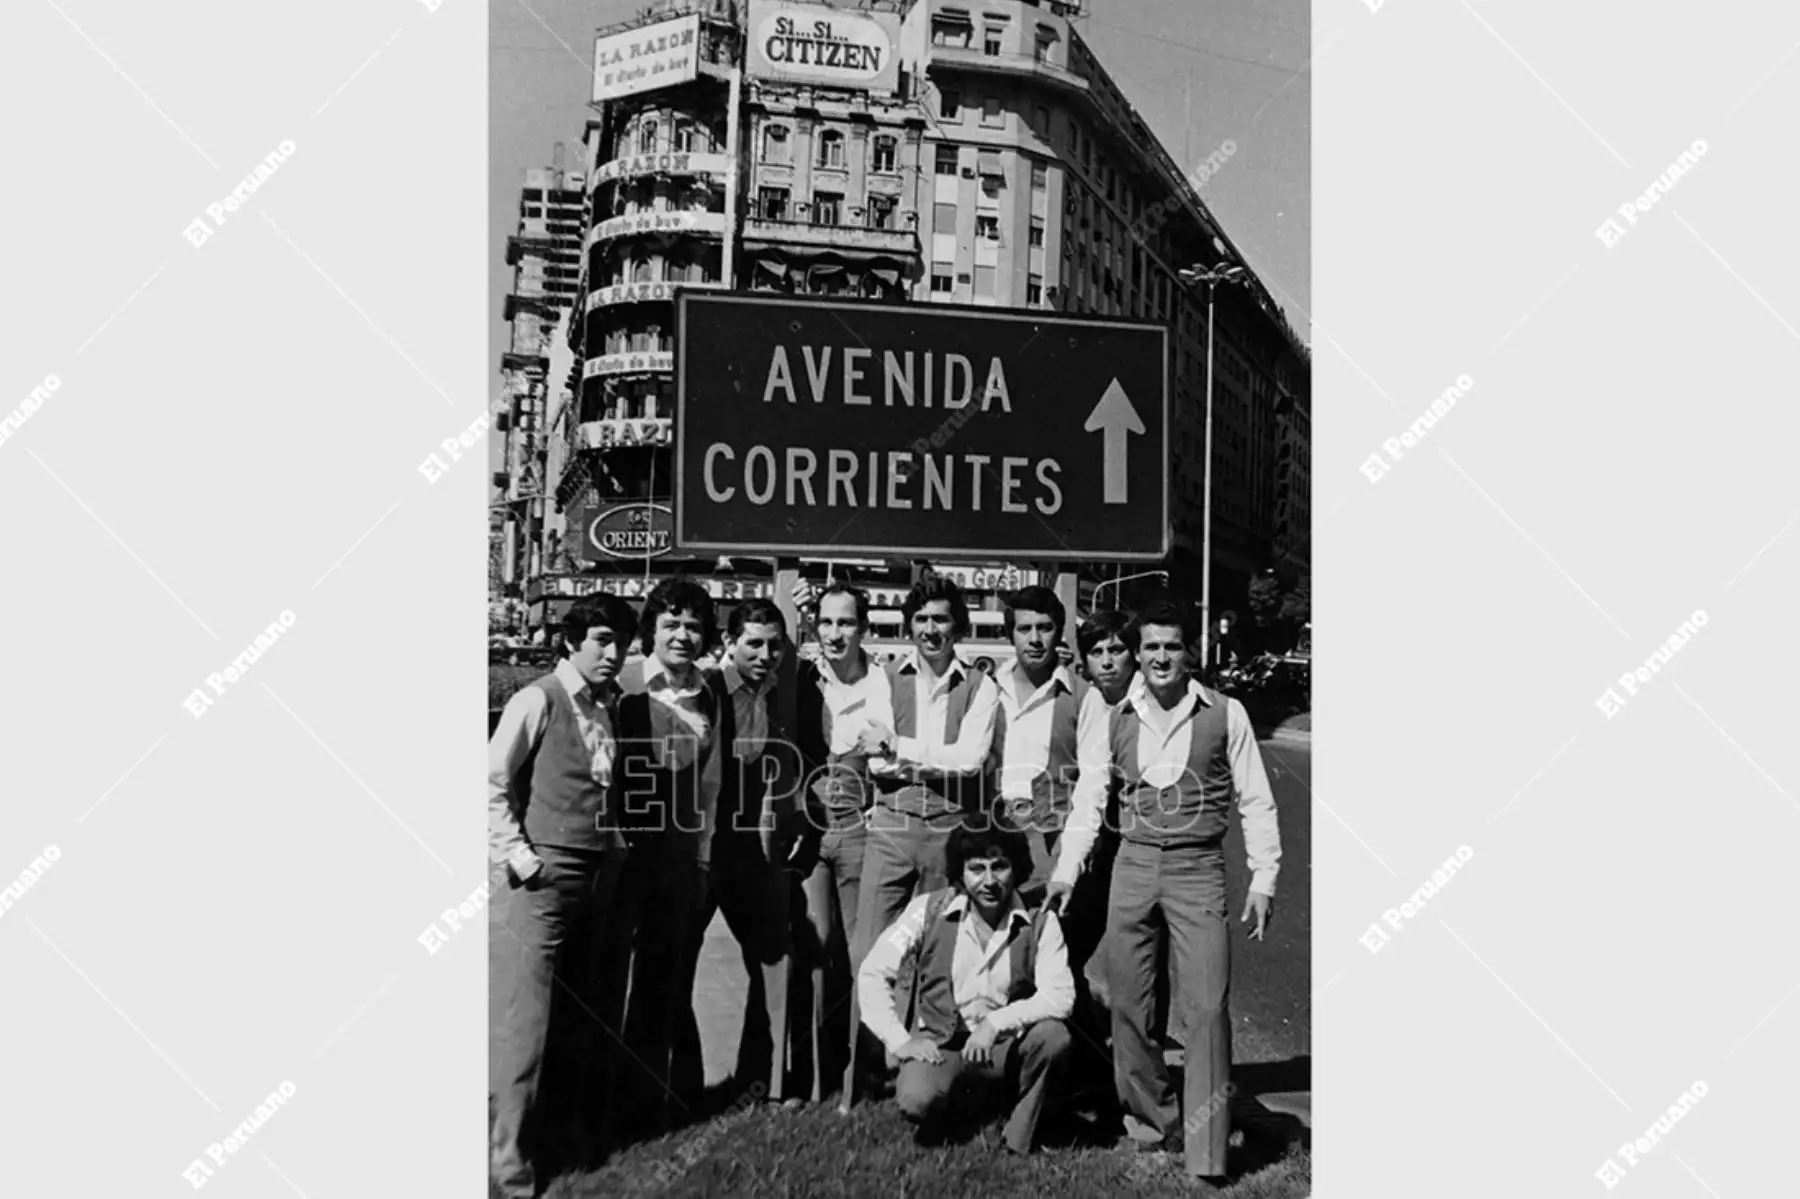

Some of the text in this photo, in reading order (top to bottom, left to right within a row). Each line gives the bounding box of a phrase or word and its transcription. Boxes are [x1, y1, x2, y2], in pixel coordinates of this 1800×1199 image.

[765, 35, 881, 72] CITIZEN
[763, 344, 1012, 413] AVENIDA
[703, 442, 1063, 515] CORRIENTES
[602, 530, 668, 549] ORIENT
